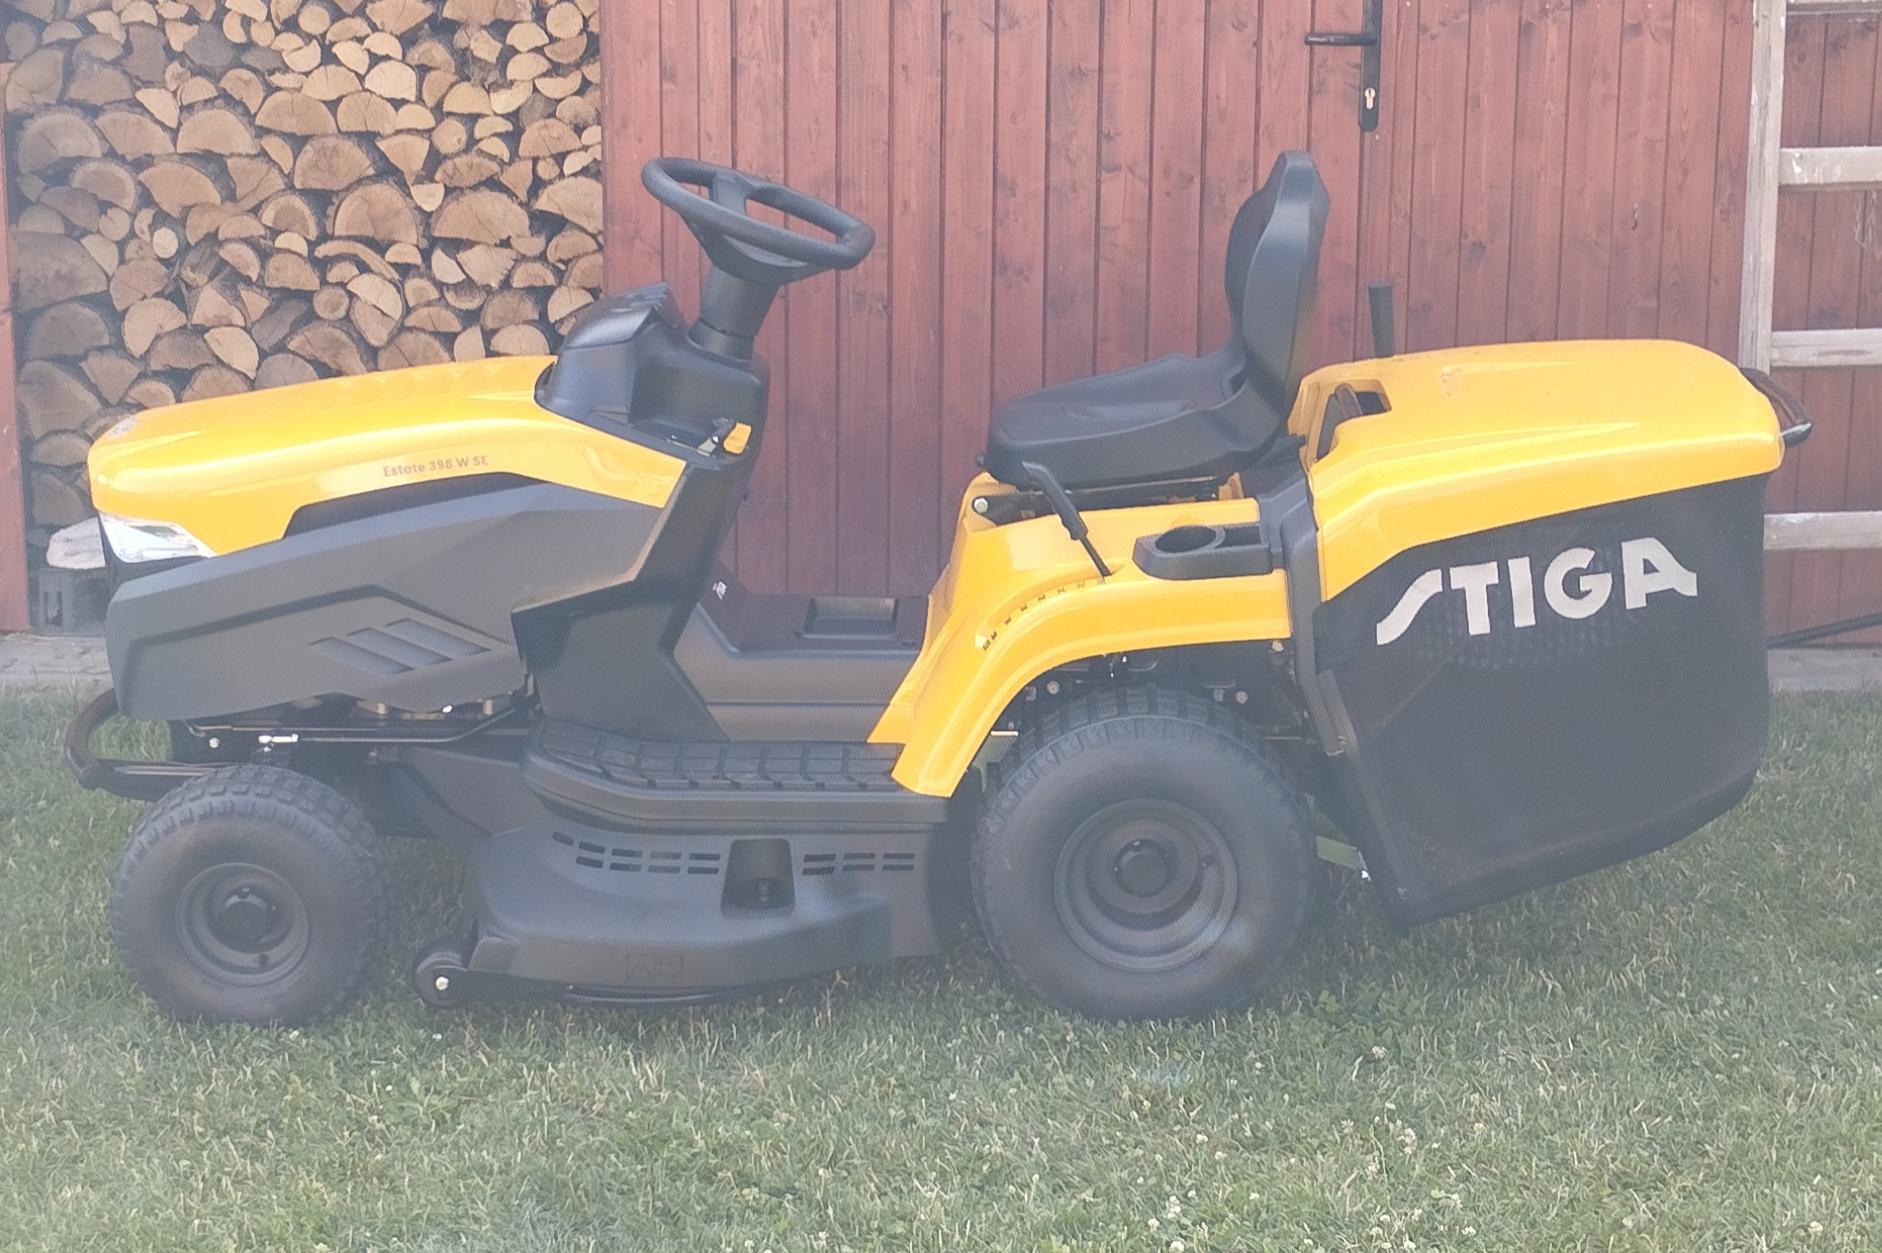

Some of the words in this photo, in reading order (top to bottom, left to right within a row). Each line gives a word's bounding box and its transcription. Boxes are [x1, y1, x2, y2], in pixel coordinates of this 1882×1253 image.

[383, 464, 425, 477] Estate
[429, 459, 453, 471] 398
[456, 457, 469, 468] W
[472, 455, 488, 466] SE
[1376, 537, 1698, 645] STIGA
